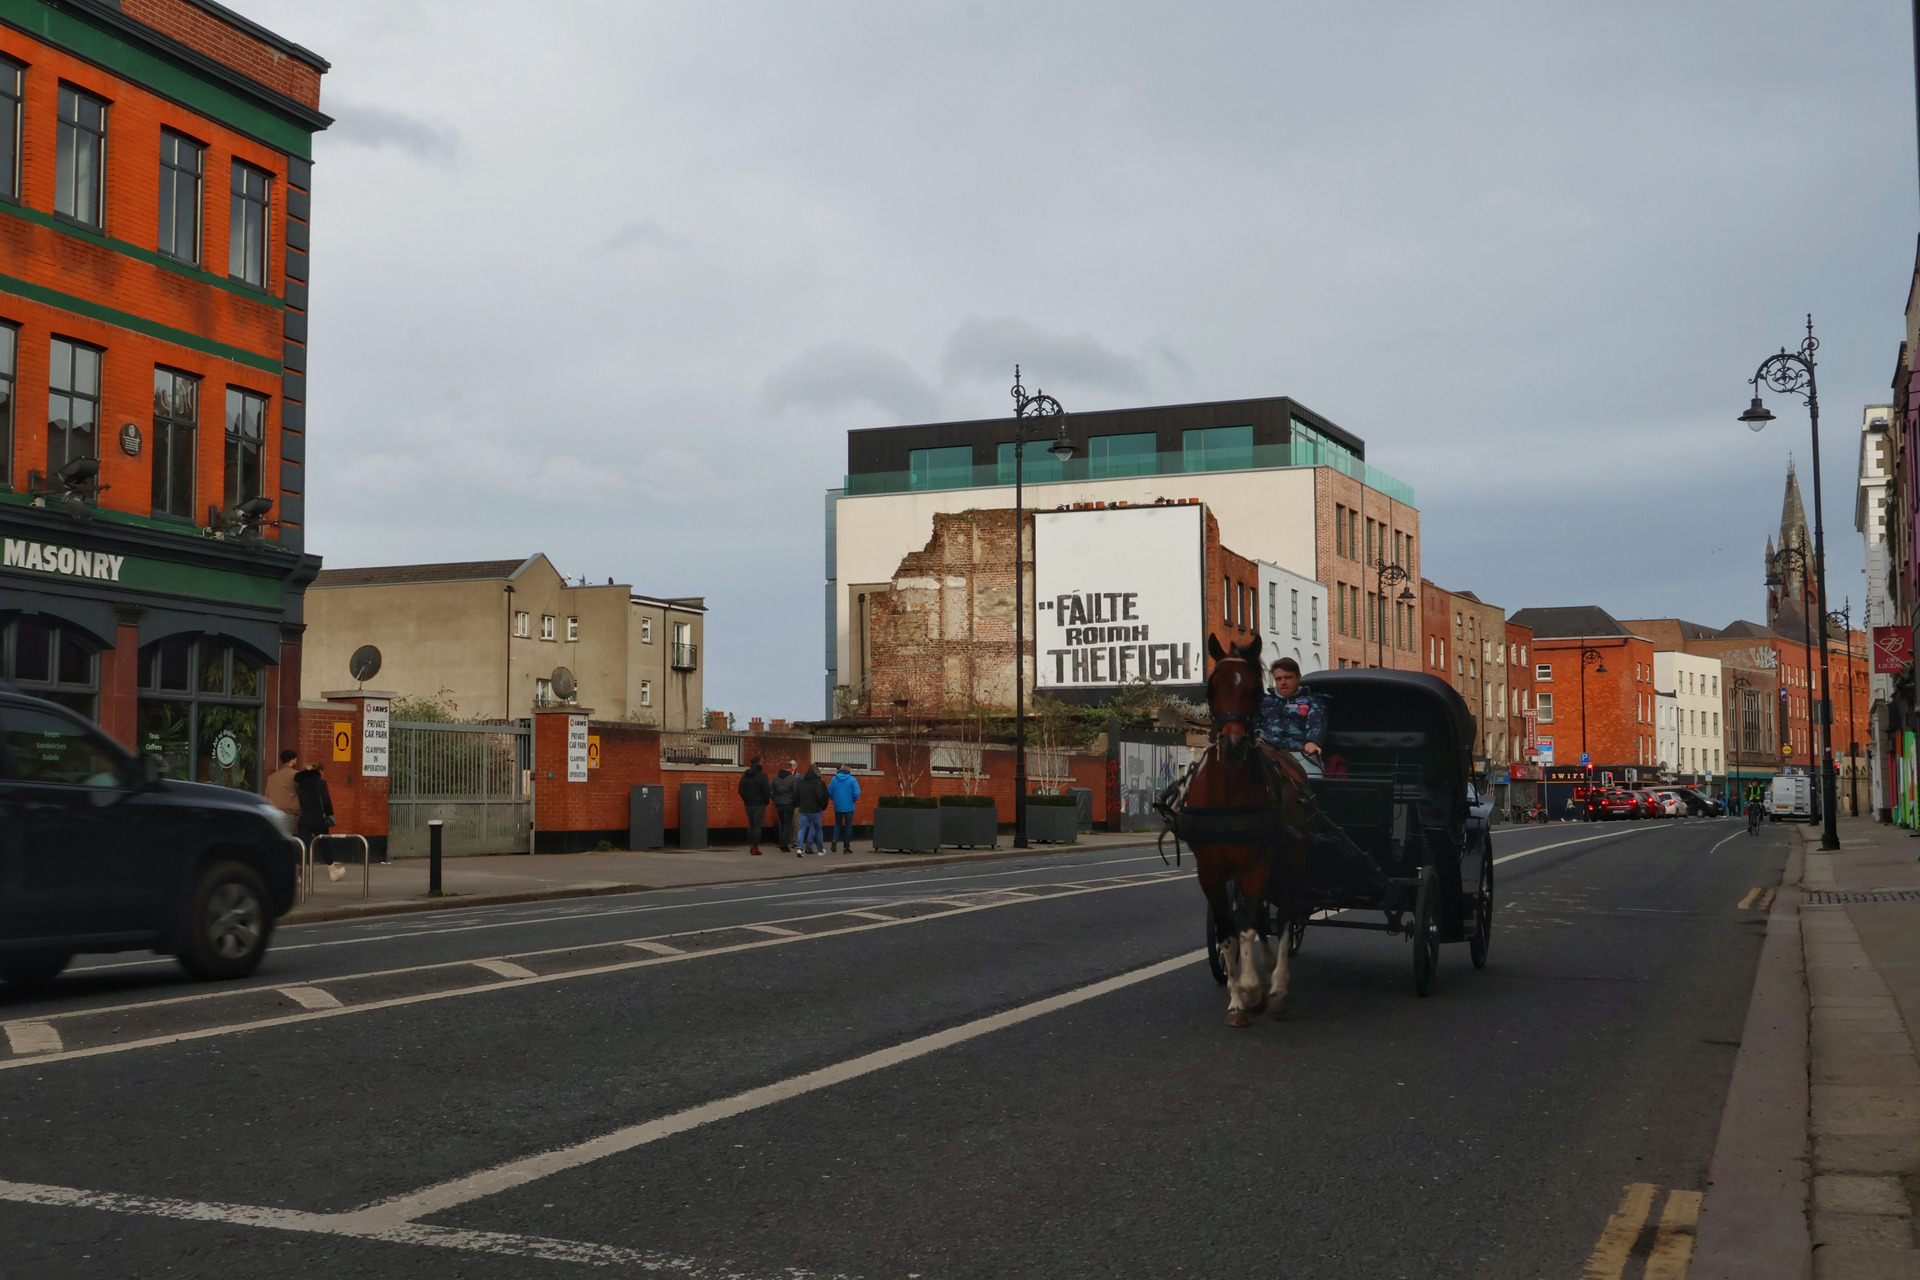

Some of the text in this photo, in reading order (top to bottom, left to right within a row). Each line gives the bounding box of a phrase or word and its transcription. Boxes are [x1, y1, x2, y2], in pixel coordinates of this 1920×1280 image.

[3, 538, 124, 582] MASONRY
[372, 705, 388, 713] IAWS
[367, 719, 386, 728] PRIVATE
[148, 732, 160, 740] Teas
[364, 729, 387, 739] CAR PARK
[571, 732, 586, 740] PRIVATE
[145, 743, 163, 751] Coffees
[569, 741, 577, 749] CAR
[365, 746, 387, 754] CLAMPING
